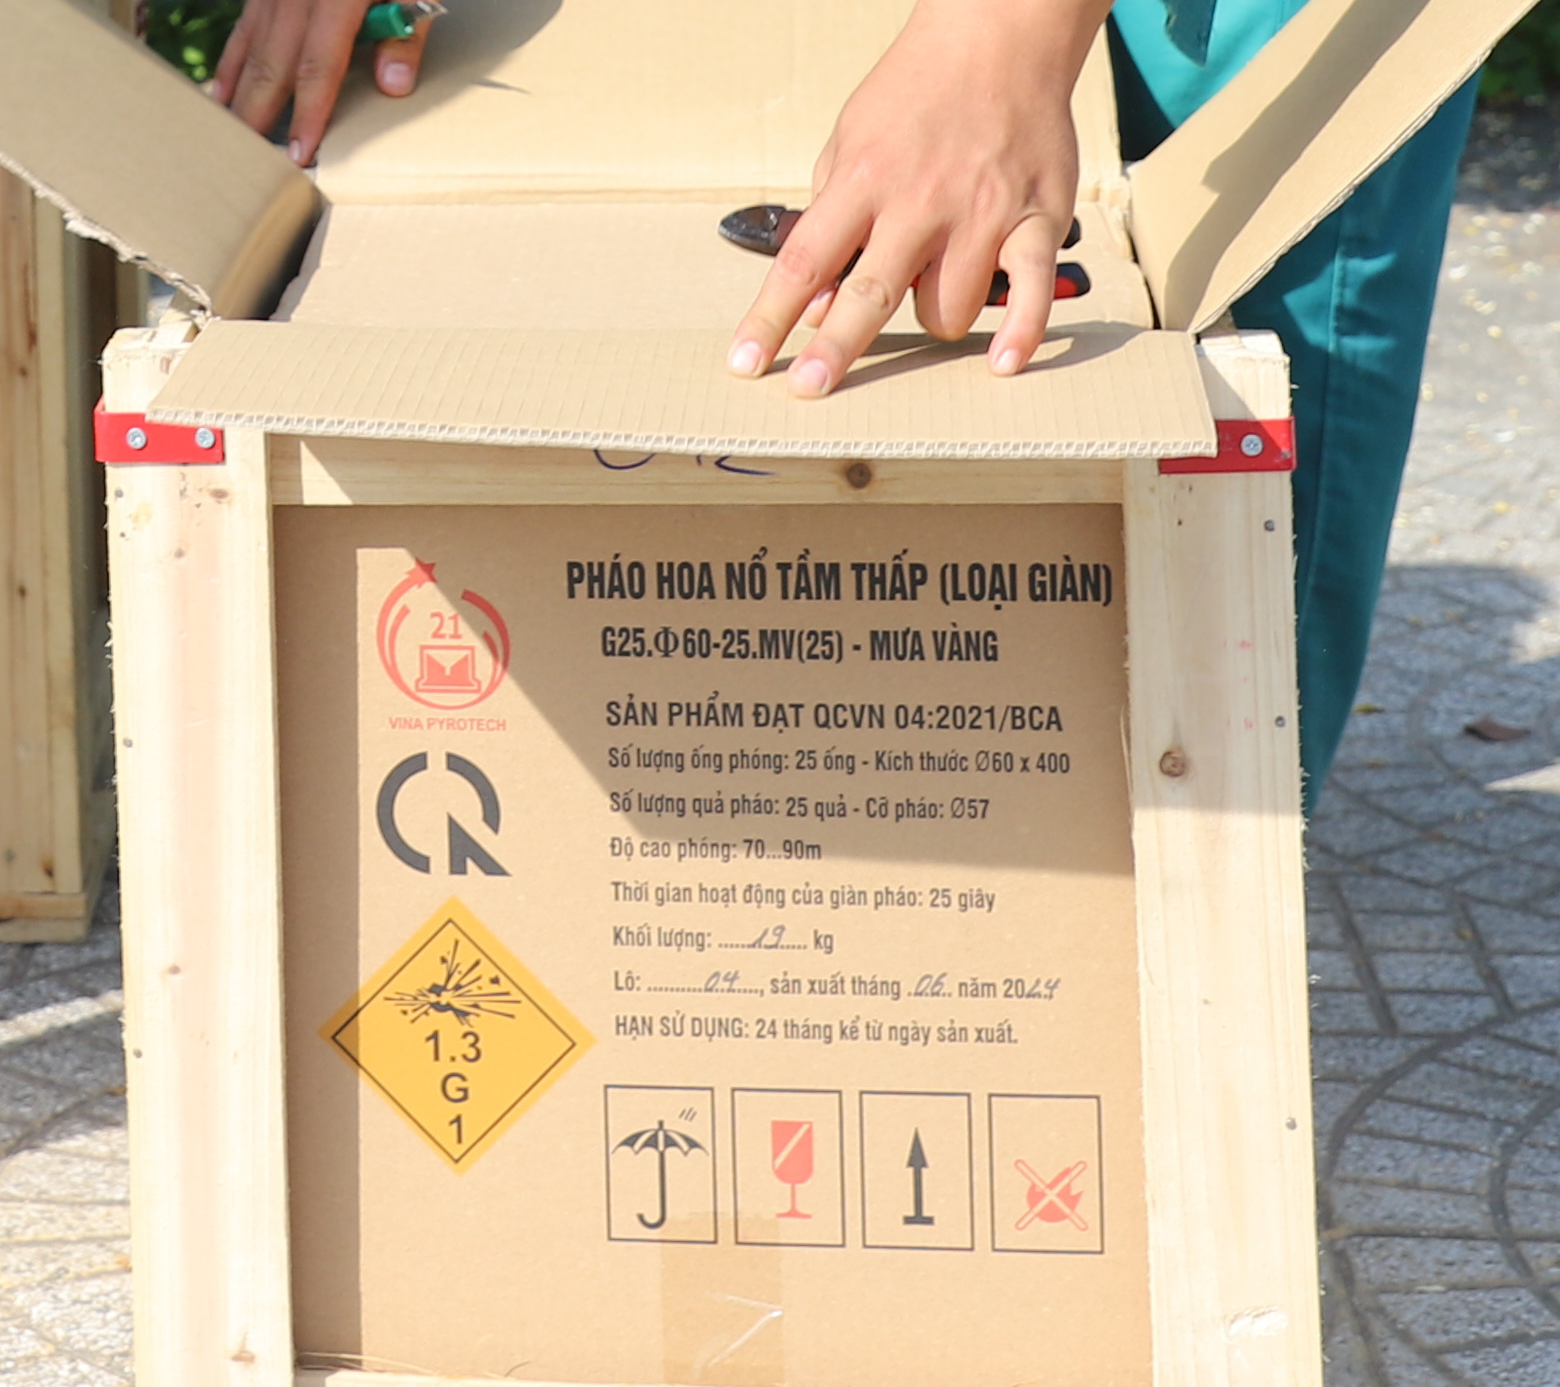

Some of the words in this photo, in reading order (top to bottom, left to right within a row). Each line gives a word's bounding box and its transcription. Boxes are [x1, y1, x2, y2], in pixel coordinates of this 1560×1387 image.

[565, 552, 647, 600] PHÁO
[655, 560, 717, 600] HOA
[724, 546, 769, 601] NỔ
[775, 548, 842, 601] TẦM
[849, 548, 929, 601] THẤP
[939, 561, 1018, 609] (LOẠI
[1027, 554, 1113, 606] GIÀN)
[429, 610, 463, 639] 21
[869, 626, 926, 661] MƯA
[931, 624, 999, 662] VÀNG
[387, 716, 424, 730] VINA
[426, 717, 508, 732] PYROTECH
[605, 692, 659, 727] SẢN
[667, 692, 745, 727] PHẨM
[751, 701, 806, 734] ĐẠT
[813, 702, 886, 729] QCVN
[893, 703, 1064, 732] 04:2021/BCA
[607, 745, 632, 769] Số
[635, 746, 686, 773] lượng
[689, 746, 724, 774] ống
[727, 747, 790, 775] phóng:
[794, 748, 819, 771] 25
[822, 747, 857, 776] ống
[874, 749, 915, 772] Kích
[918, 748, 970, 772] thước
[1019, 755, 1032, 773] x
[1034, 751, 1071, 774] 400
[608, 787, 635, 813] Số
[637, 791, 687, 818] lượng
[691, 789, 726, 819] quả
[729, 791, 781, 819] pháo:
[784, 795, 809, 818] 25
[813, 792, 848, 821] quả
[864, 795, 890, 819] Cỡ
[894, 795, 945, 822] pháo:
[607, 835, 635, 862] Độ
[639, 839, 672, 858] cao
[676, 835, 738, 864] phóng:
[609, 879, 650, 902] Thời
[653, 880, 694, 907] gian
[697, 881, 738, 908] hoạt
[741, 882, 787, 909] động
[790, 880, 825, 906] của
[829, 883, 869, 910] giàn
[873, 884, 924, 911] pháo:
[928, 886, 953, 909] 25
[957, 887, 997, 914] giây
[612, 926, 652, 949] Khối
[656, 927, 713, 953] lượng:
[812, 929, 835, 954] kg
[612, 970, 643, 993] Lô:
[769, 974, 803, 996] sản
[806, 972, 847, 996] xuất
[850, 974, 902, 1000] tháng
[957, 976, 998, 999] năm
[614, 1013, 654, 1041] HẠN
[658, 1011, 687, 1038] SỬ
[690, 1015, 750, 1043] DỤNG:
[754, 1016, 779, 1040] 24
[782, 1017, 834, 1045] tháng
[838, 1014, 861, 1041] kể
[864, 1018, 884, 1042] từ
[887, 1019, 932, 1047] ngày
[935, 1017, 970, 1043] sản
[973, 1017, 1019, 1044] xuất.
[424, 1029, 482, 1065] 1.3
[441, 1071, 471, 1106] G
[448, 1114, 467, 1146] 1
